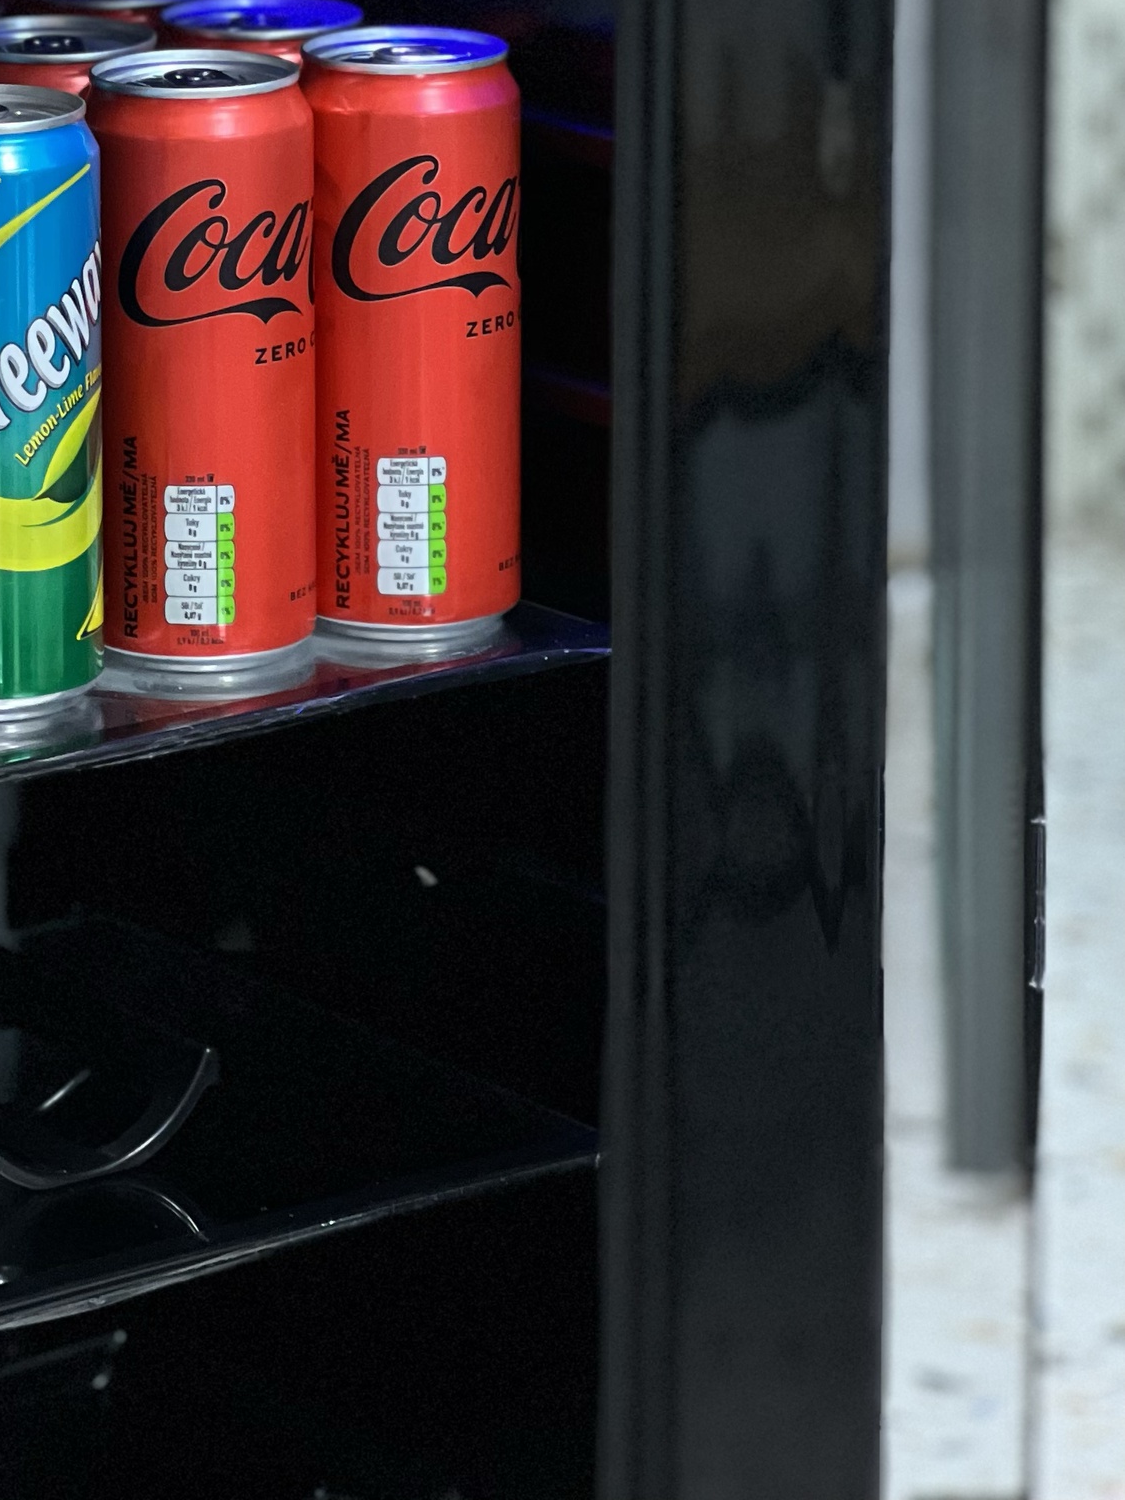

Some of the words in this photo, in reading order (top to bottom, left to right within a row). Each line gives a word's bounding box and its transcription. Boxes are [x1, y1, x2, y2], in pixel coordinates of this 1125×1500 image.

[255, 337, 306, 365] ZERO
[466, 311, 515, 338] ZERO
[14, 383, 84, 467] Lemon-Lime
[331, 409, 352, 488] MĚ/MA
[119, 436, 139, 516] MĚ/MA
[122, 519, 138, 639] RECYKLUJ
[336, 492, 350, 609] RECYKLUJ
